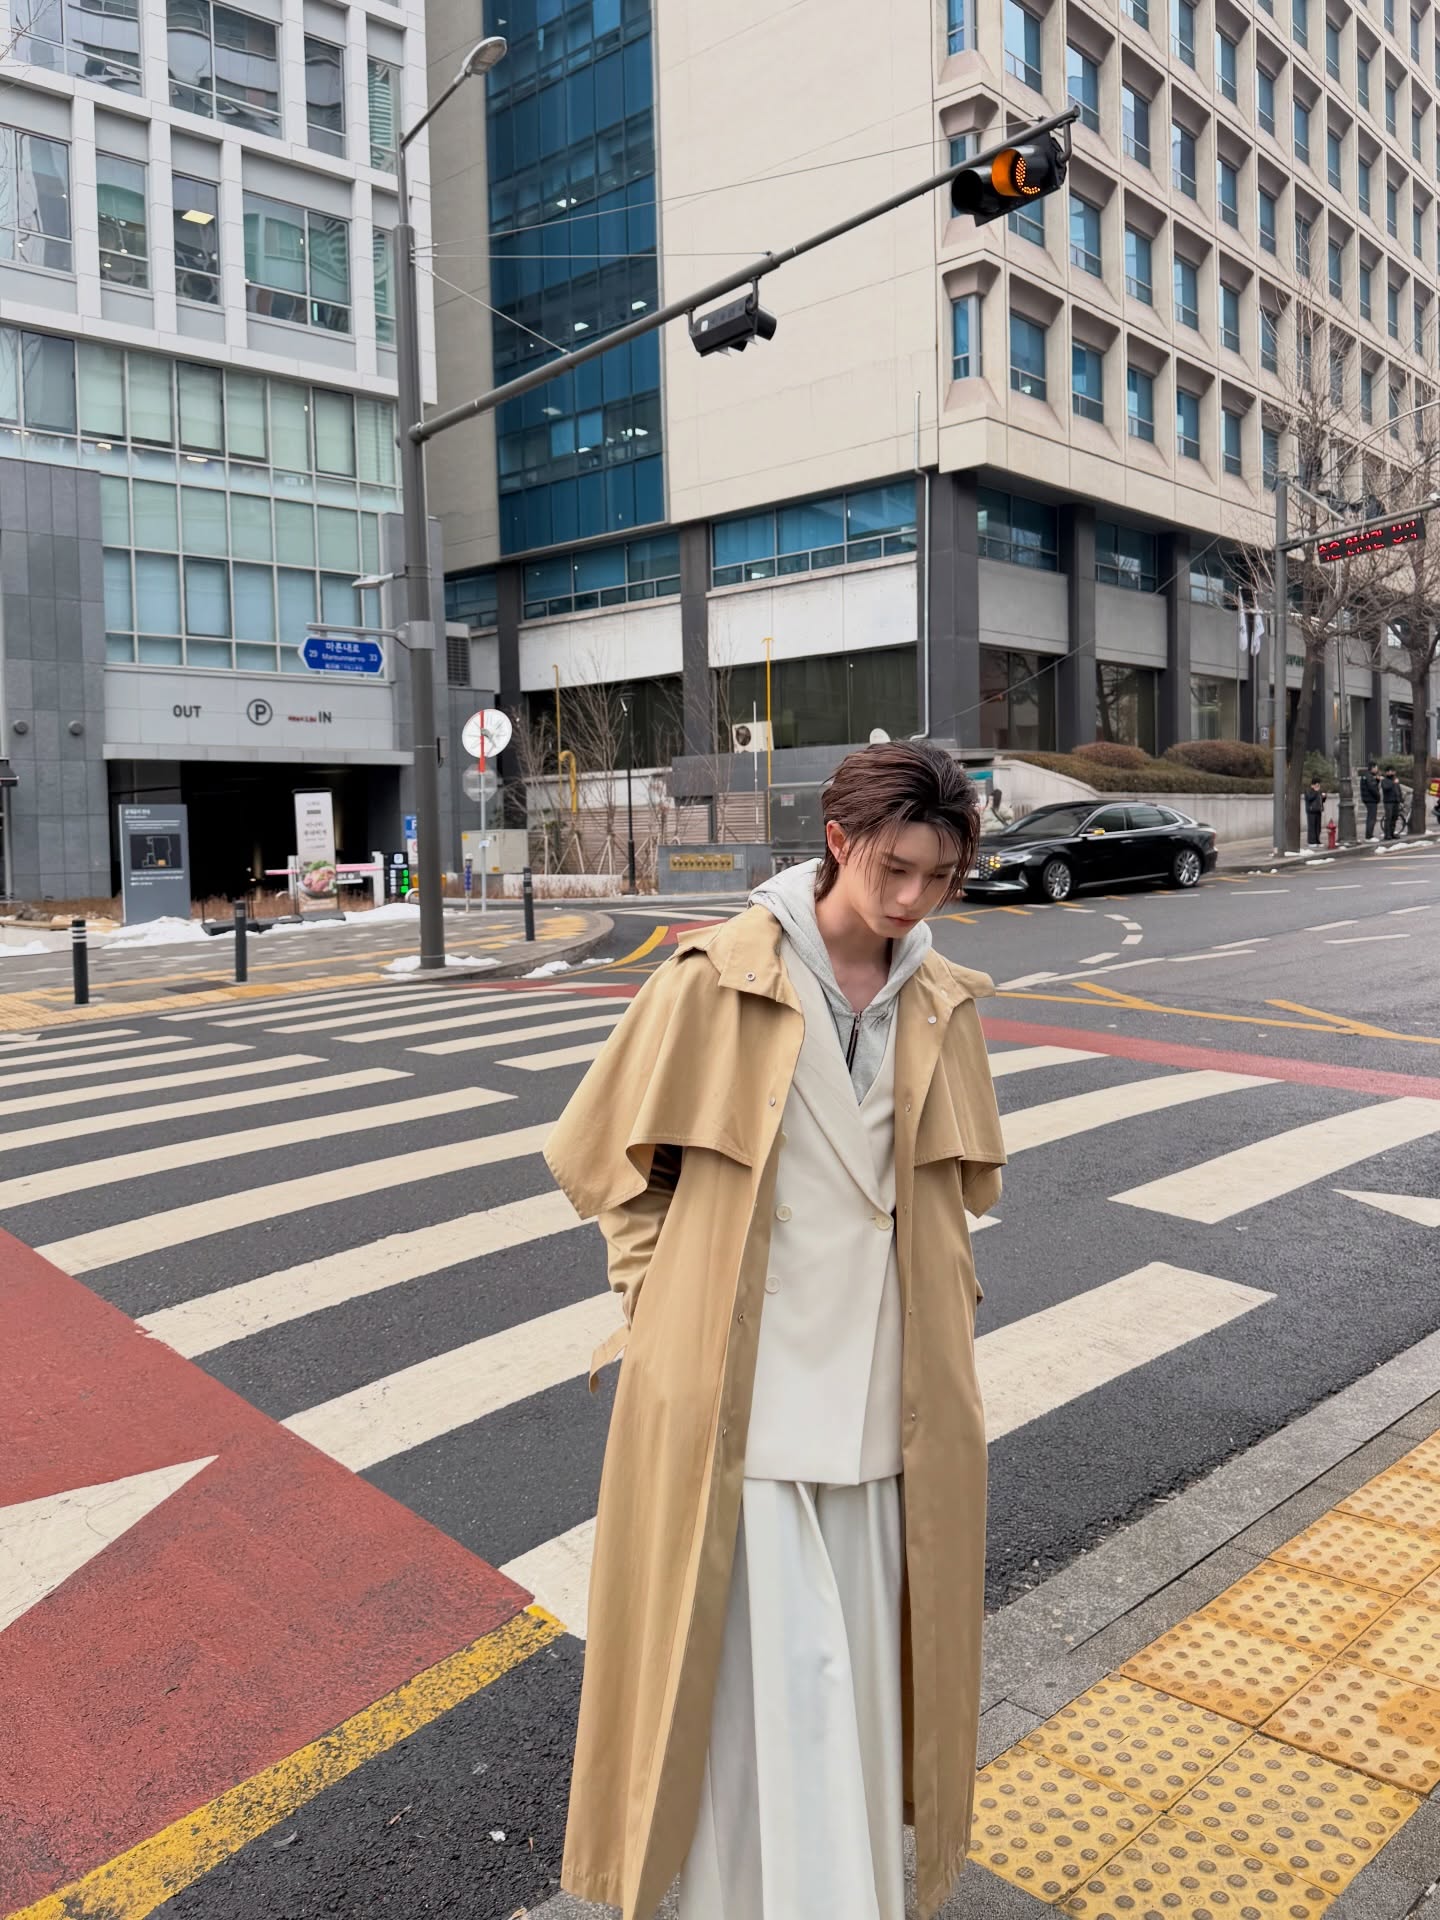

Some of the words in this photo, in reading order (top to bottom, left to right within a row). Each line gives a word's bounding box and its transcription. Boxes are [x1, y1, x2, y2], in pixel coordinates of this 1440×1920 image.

[325, 641, 360, 653] 마른내로
[173, 704, 202, 718] OUT
[255, 704, 267, 721] P
[318, 711, 332, 724] IN
